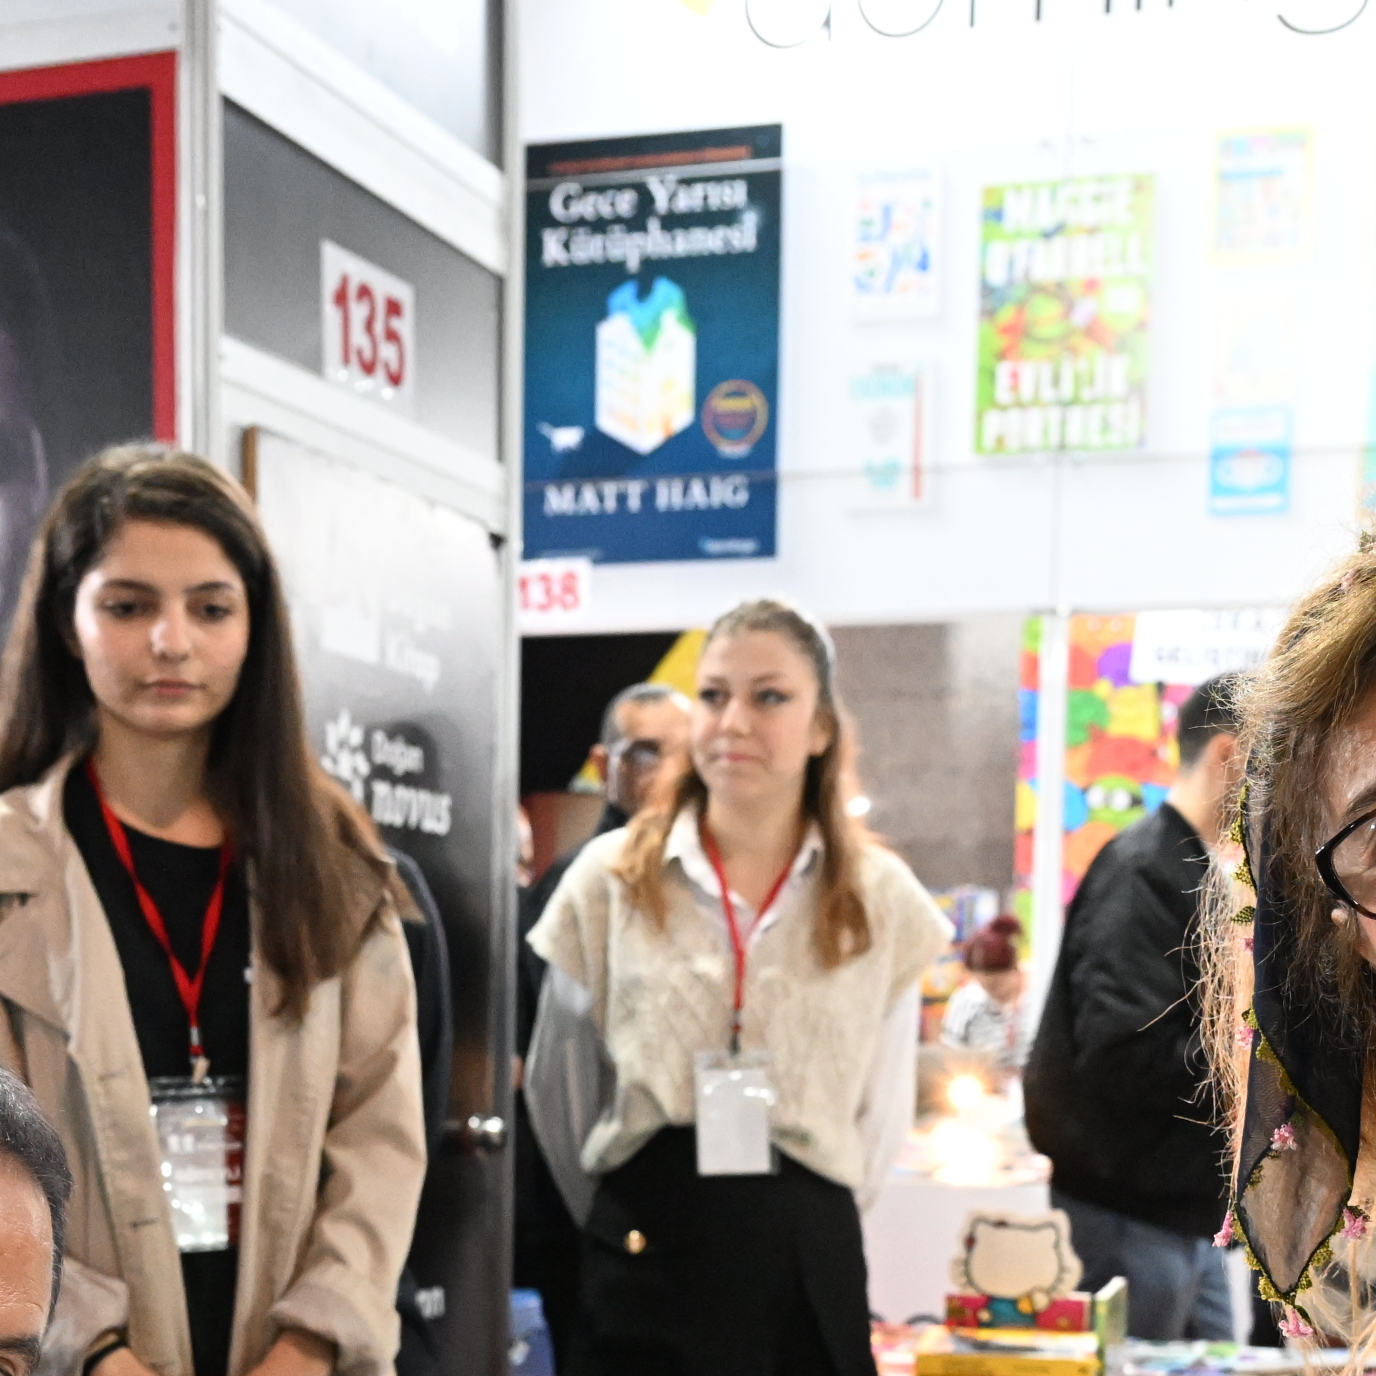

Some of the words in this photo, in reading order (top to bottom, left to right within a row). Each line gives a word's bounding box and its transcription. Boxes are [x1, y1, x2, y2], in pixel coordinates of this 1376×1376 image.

[548, 181, 639, 224] Gece
[332, 273, 406, 388] 135
[543, 478, 649, 517] MATT
[655, 474, 750, 512] HAIG
[519, 570, 581, 613] 138
